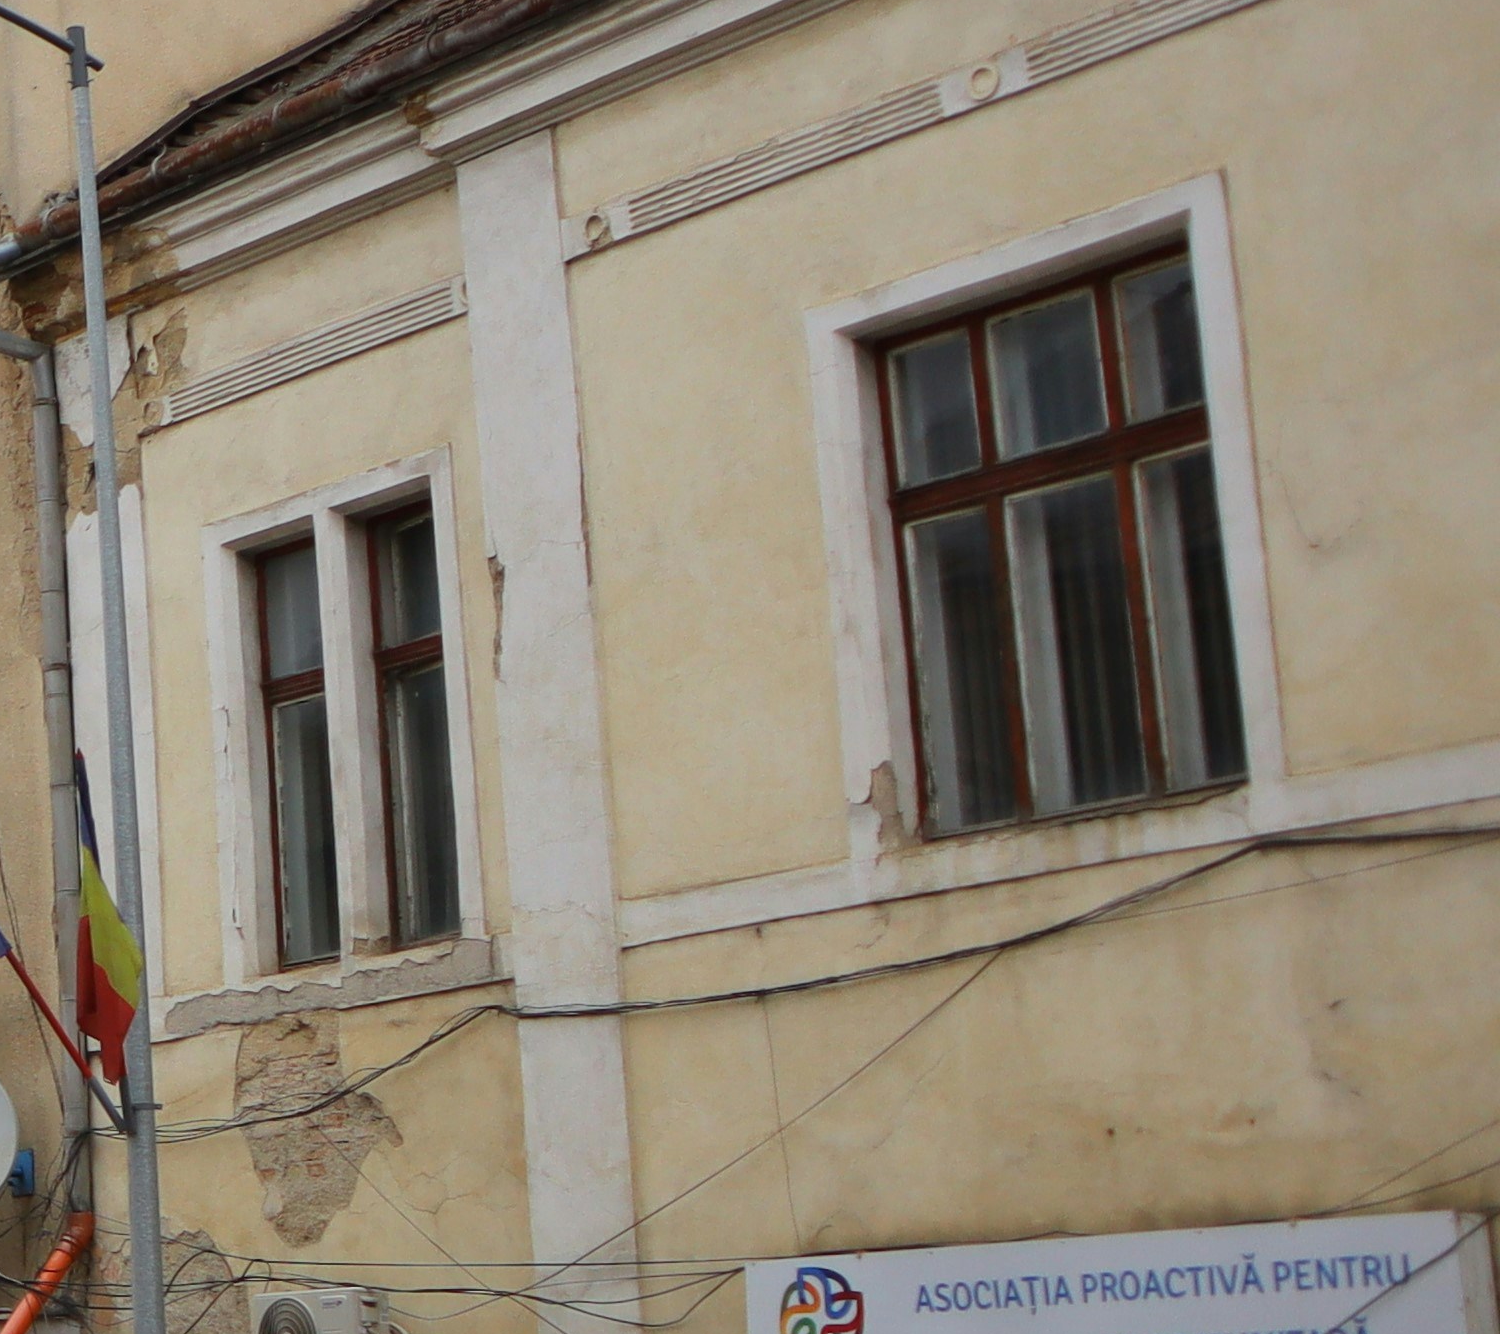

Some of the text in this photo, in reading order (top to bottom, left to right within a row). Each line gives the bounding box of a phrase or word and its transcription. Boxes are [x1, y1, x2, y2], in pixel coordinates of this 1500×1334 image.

[915, 1252, 1411, 1315] ASOCIAȚIA PROACTIVĂ PENTRU
